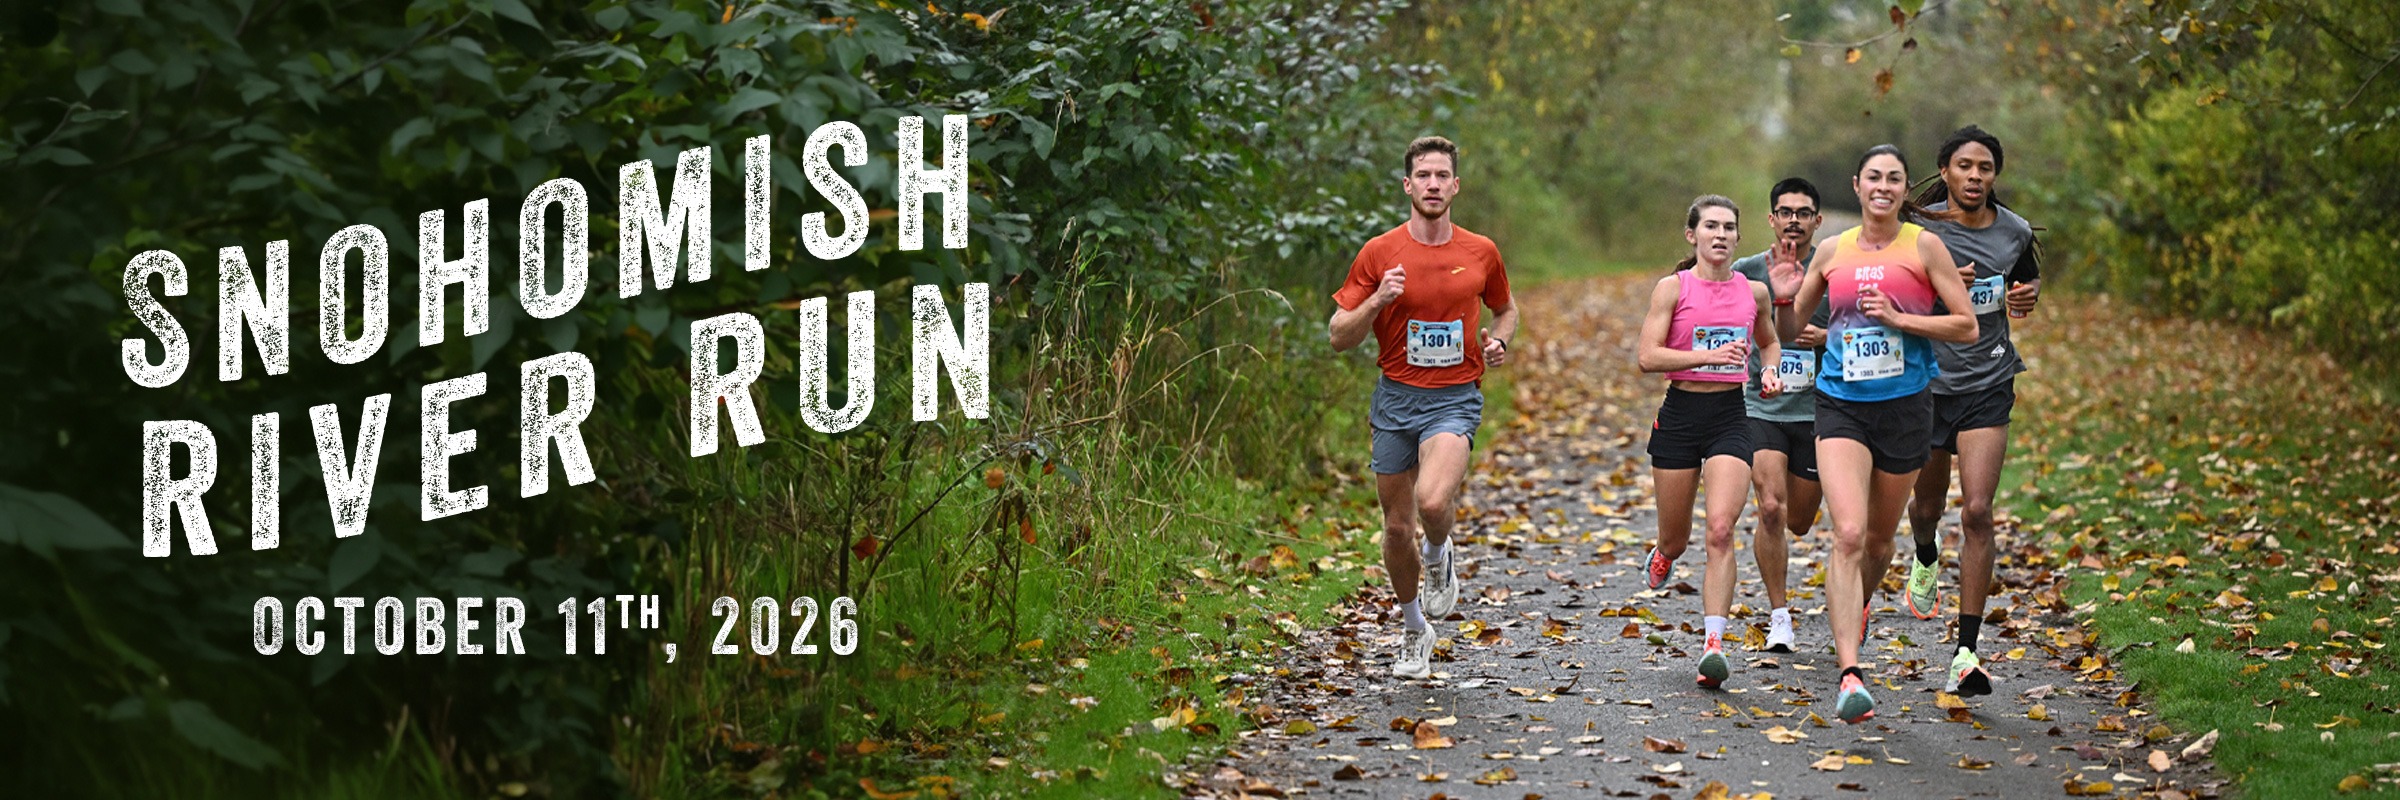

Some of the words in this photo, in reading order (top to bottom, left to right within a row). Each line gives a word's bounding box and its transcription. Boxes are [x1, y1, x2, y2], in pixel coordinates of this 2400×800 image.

[1971, 289, 1993, 305] 437
[1421, 333, 1452, 348] 1301
[1855, 340, 1890, 357] 1303
[1781, 361, 1803, 375] 879
